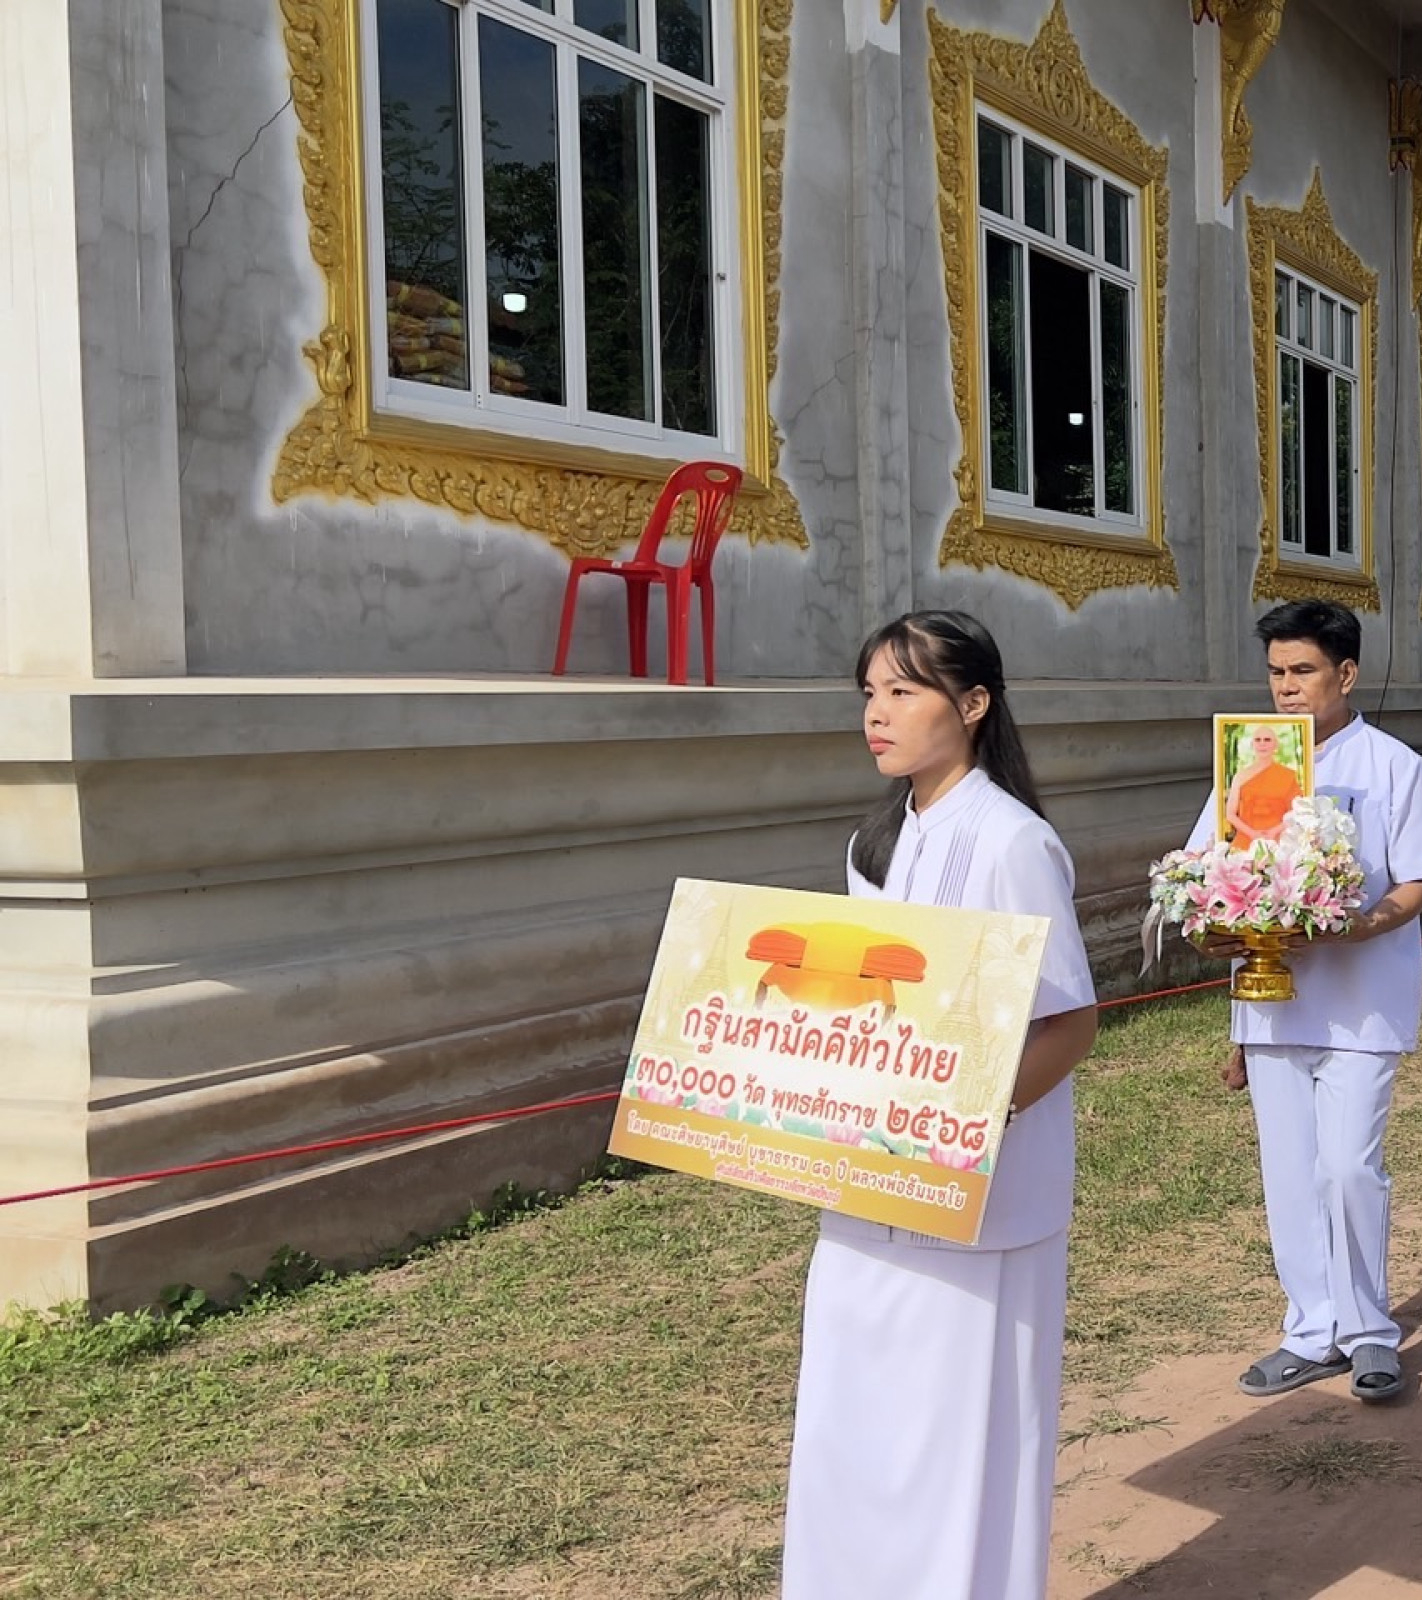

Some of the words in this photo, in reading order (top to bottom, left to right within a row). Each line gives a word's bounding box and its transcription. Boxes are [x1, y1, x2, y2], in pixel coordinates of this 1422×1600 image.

[683, 996, 958, 1083] กฐินสามัคคีทั่วไทย
[637, 1057, 736, 1099] ๓๐,๐๐๐
[743, 1073, 766, 1106] วัด
[771, 1087, 877, 1128] พุทธศักราช
[886, 1099, 989, 1150] ๒๕๖๘
[837, 1159, 848, 1181] ปี
